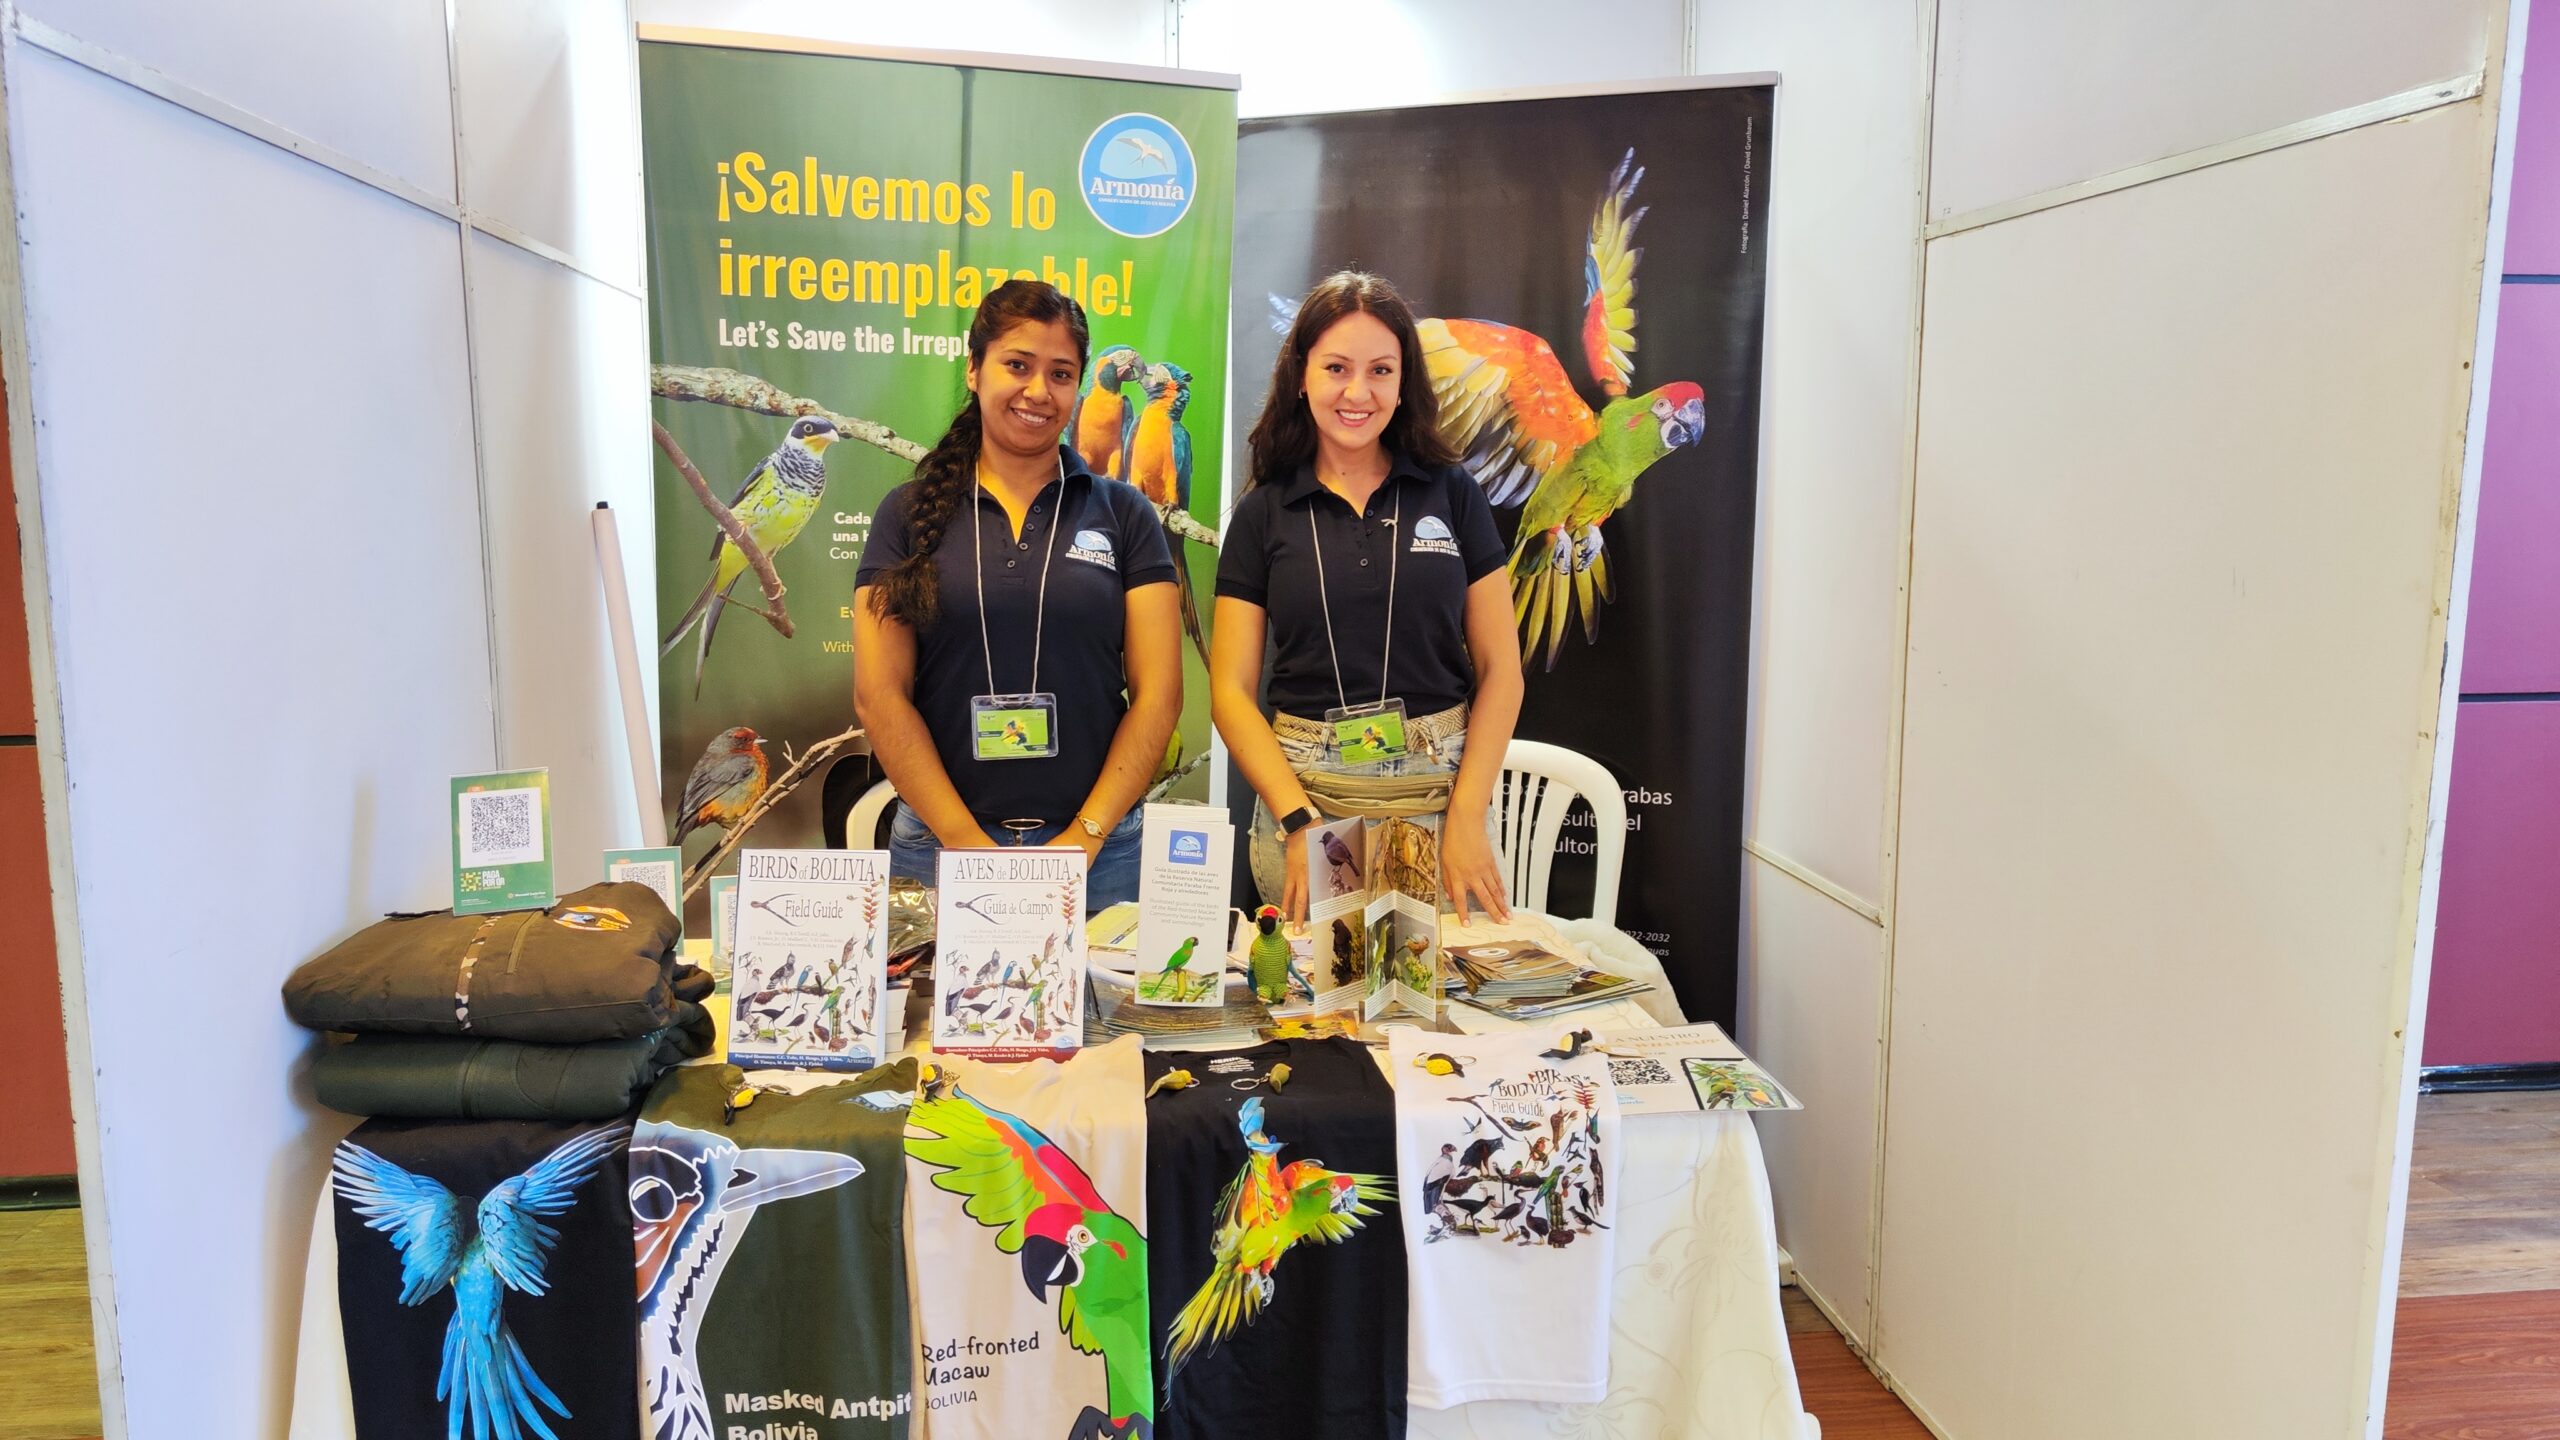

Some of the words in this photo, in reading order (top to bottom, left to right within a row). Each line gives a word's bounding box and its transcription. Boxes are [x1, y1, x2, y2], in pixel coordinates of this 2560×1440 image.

[717, 151, 991, 227] ¡Salvemos
[1011, 171, 1056, 231] lo
[1089, 177, 1185, 201] Armonía
[719, 238, 1134, 318] irreemplazble!
[787, 321, 847, 351] Save
[854, 325, 894, 354] the
[903, 327, 970, 362] Irrepl
[834, 511, 872, 525] Cada
[833, 531, 859, 542] una
[829, 547, 858, 560] Con
[823, 641, 855, 653] With
[1563, 811, 1597, 828] sult
[1555, 836, 1598, 855] ultor
[749, 855, 798, 880] BIRDS
[799, 866, 809, 880] of
[810, 857, 876, 882] BOLIVIA
[955, 858, 995, 880] AVES
[997, 866, 1007, 880] de
[1009, 858, 1072, 880] BOLIVIA
[785, 899, 810, 918] Field
[812, 901, 844, 919] Guide
[1008, 902, 1017, 915] de
[1019, 899, 1054, 921] Campo
[922, 1331, 1040, 1364] Red-fronted
[924, 1365, 990, 1386] Macaw
[724, 1389, 825, 1416] Masked
[830, 1392, 912, 1422] Antpit
[727, 1421, 819, 1440] Bolivia
